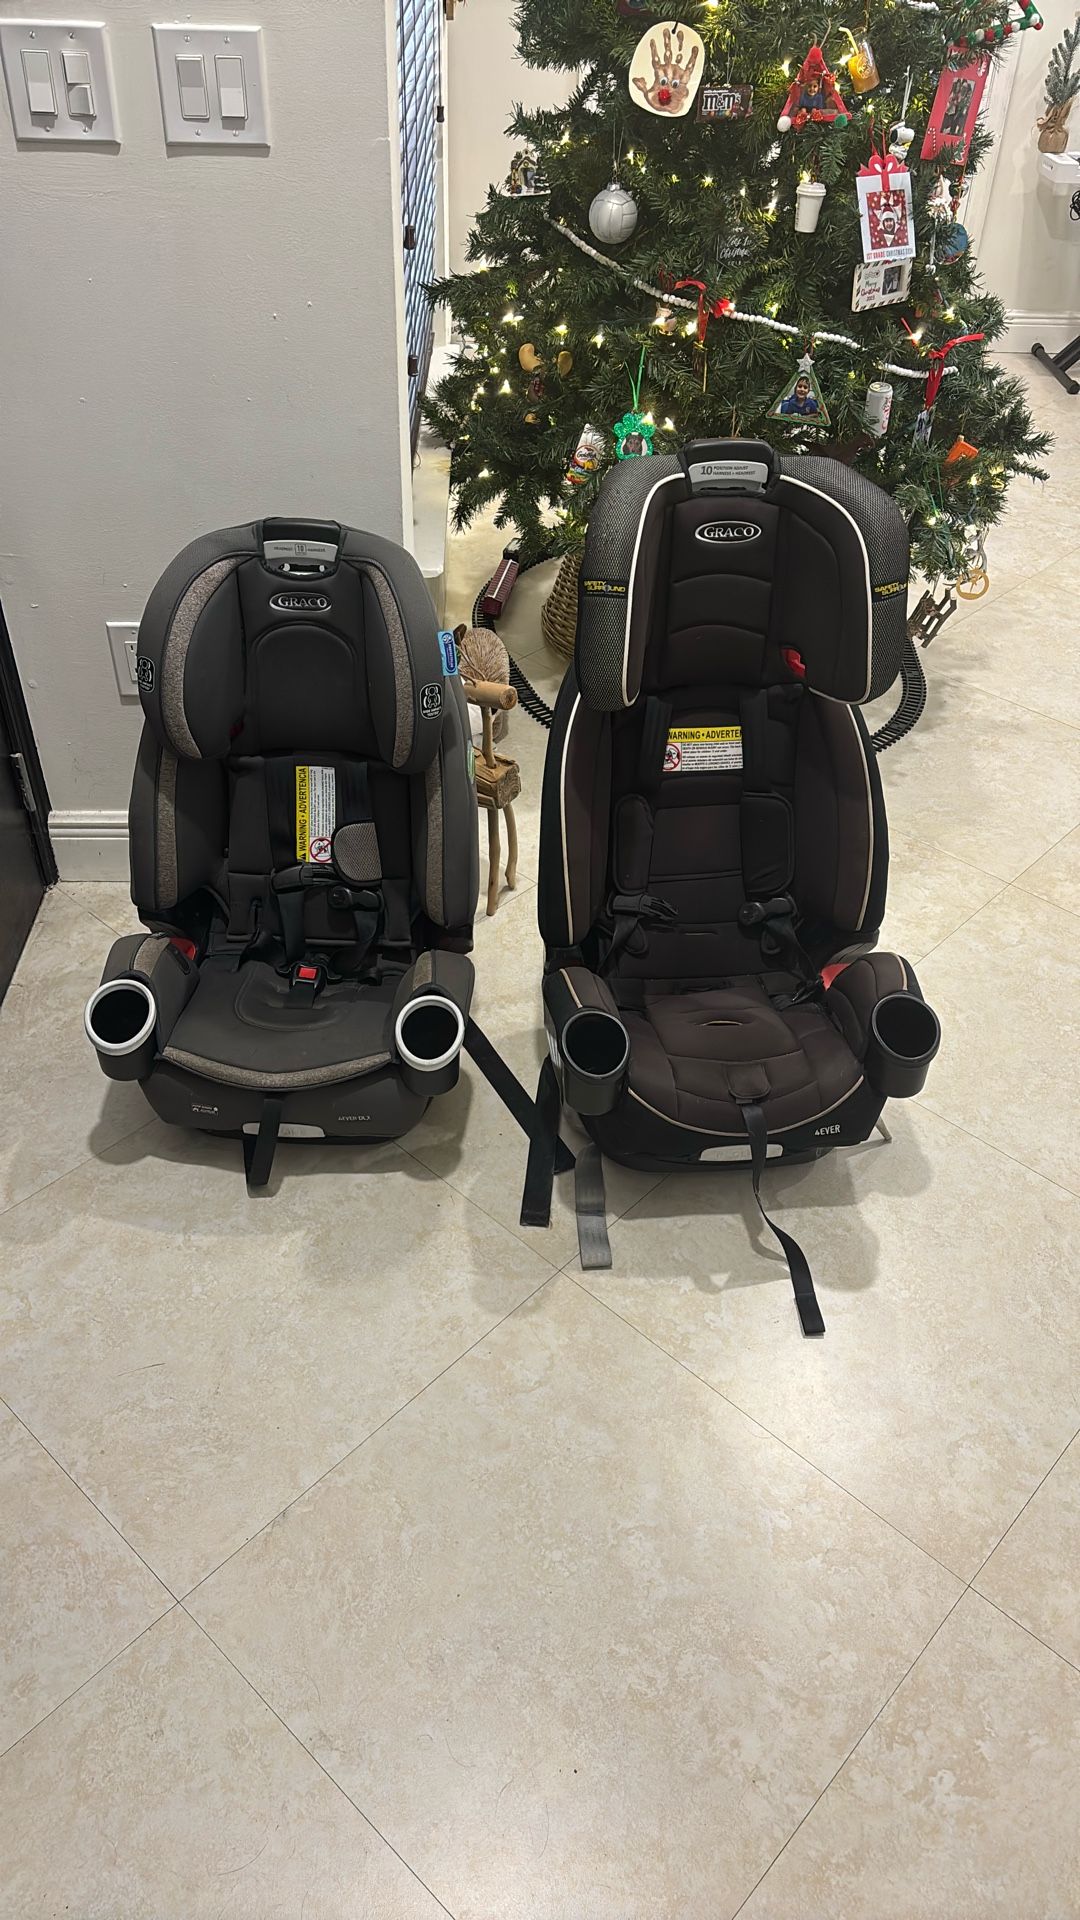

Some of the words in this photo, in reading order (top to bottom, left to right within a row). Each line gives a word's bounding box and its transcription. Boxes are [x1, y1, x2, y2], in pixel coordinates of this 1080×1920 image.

[701, 465, 713, 476] 10
[704, 526, 755, 538] GRACO
[278, 596, 328, 608] GRACO
[299, 768, 307, 815] ADVERTENCIA
[299, 819, 307, 852] WARNING
[815, 1124, 841, 1136] 4EVER
